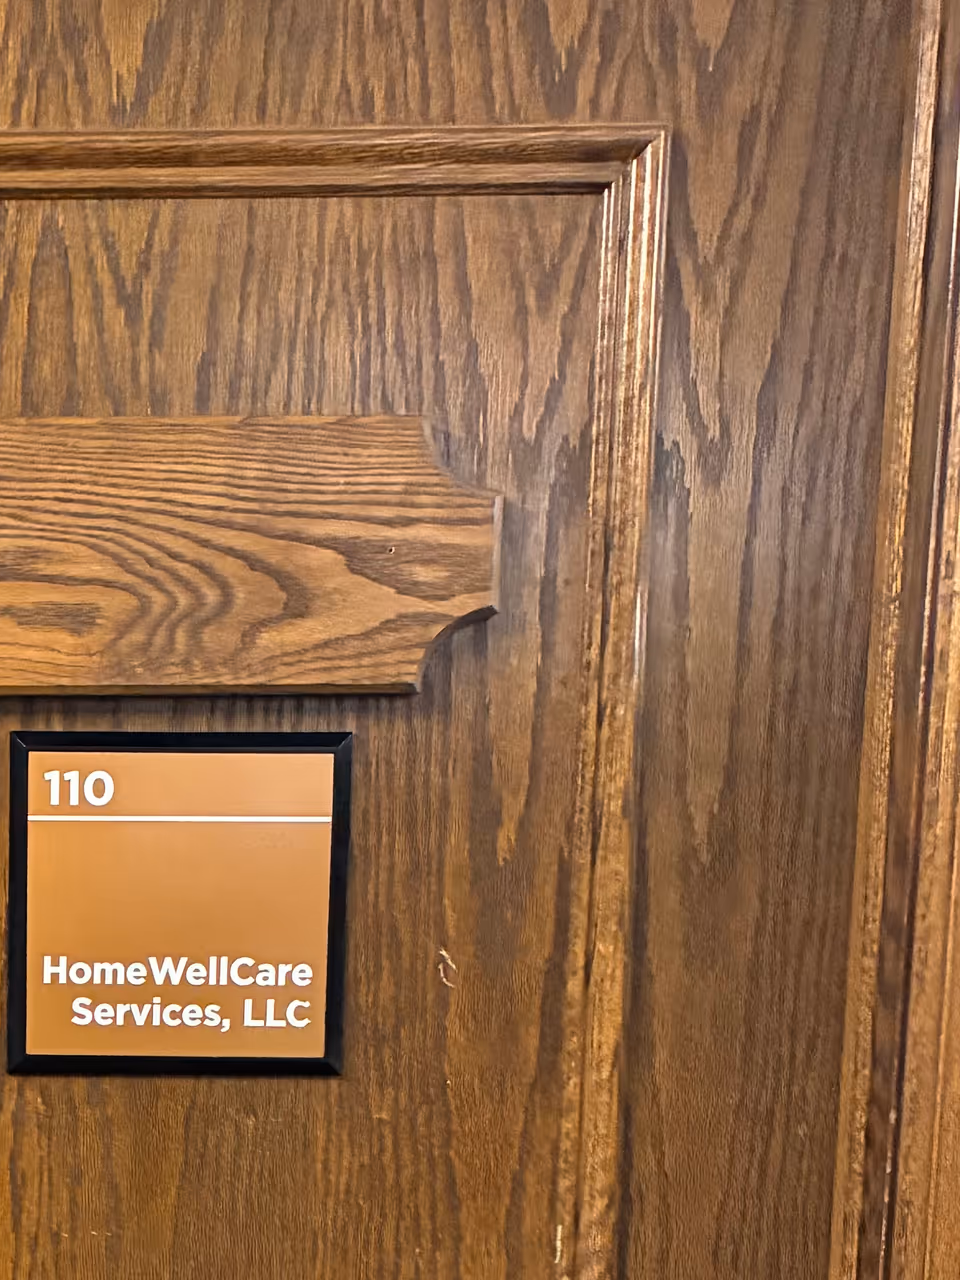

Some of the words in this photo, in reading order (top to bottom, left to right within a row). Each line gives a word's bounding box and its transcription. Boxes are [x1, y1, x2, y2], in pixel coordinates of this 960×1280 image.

[43, 770, 115, 807] 110
[43, 955, 313, 987] HomeWellCare
[70, 997, 231, 1033] Services,
[243, 998, 312, 1029] LLC
